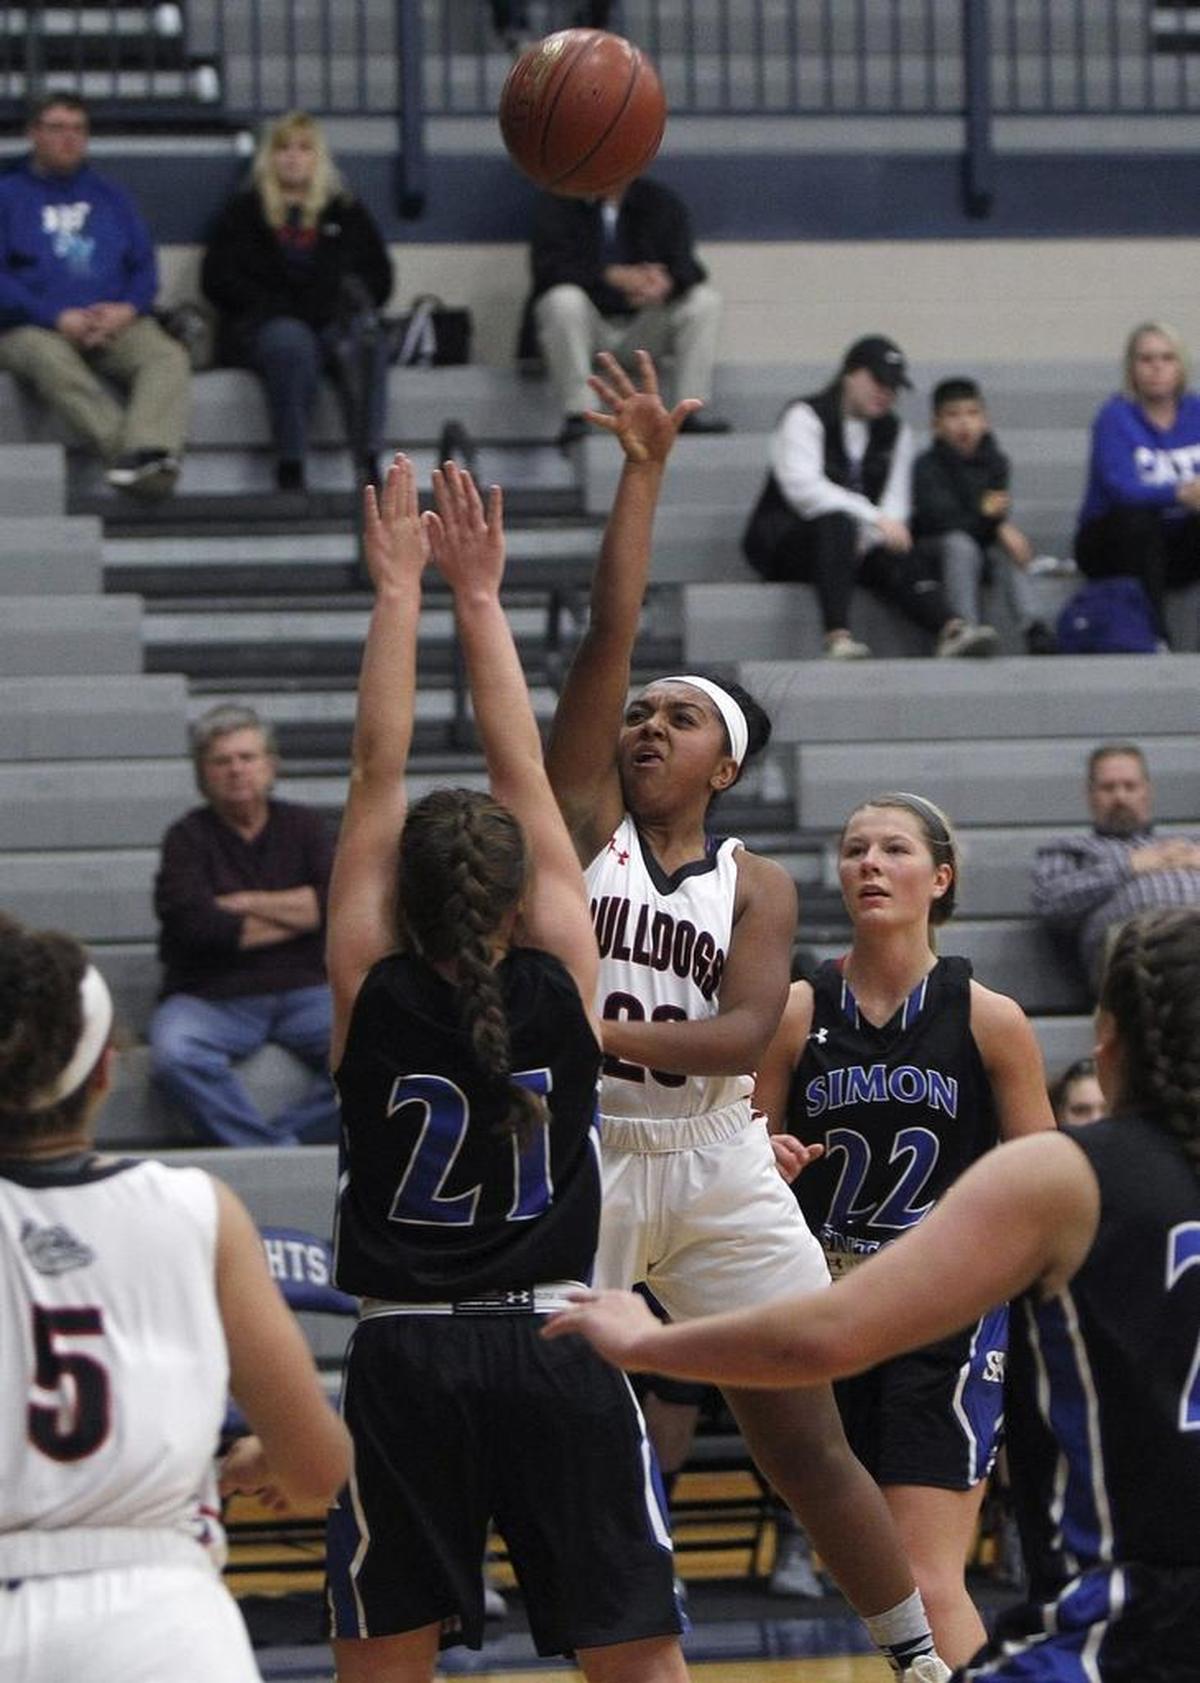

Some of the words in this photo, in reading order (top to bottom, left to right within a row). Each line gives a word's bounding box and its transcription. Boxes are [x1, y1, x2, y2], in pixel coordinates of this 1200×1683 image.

[386, 1067, 553, 1227] 21
[806, 1064, 958, 1118] SIMON
[825, 1126, 940, 1229] 22
[28, 1302, 112, 1463] 5
